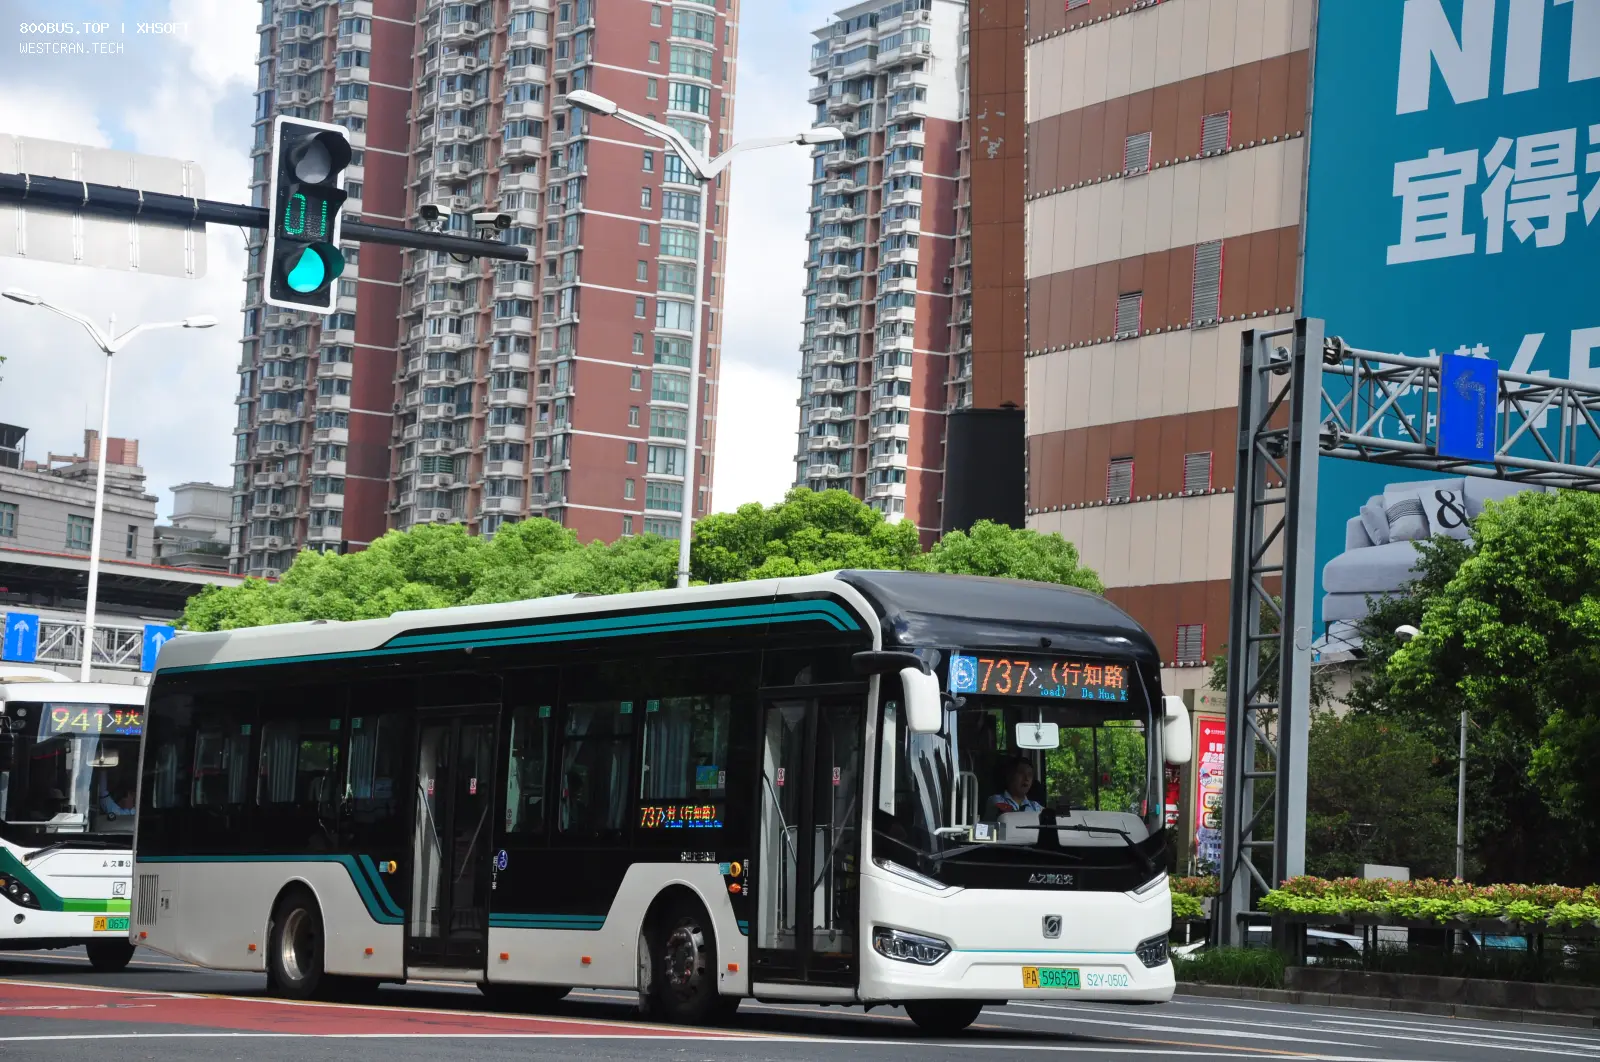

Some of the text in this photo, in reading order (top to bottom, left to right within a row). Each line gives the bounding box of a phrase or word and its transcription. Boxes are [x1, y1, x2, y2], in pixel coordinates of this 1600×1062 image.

[1386, 123, 1600, 265] 宜得
[978, 658, 1030, 694] 737
[51, 707, 104, 732] 941
[640, 806, 663, 829] 737
[1087, 973, 1129, 987] S2Y-0502
